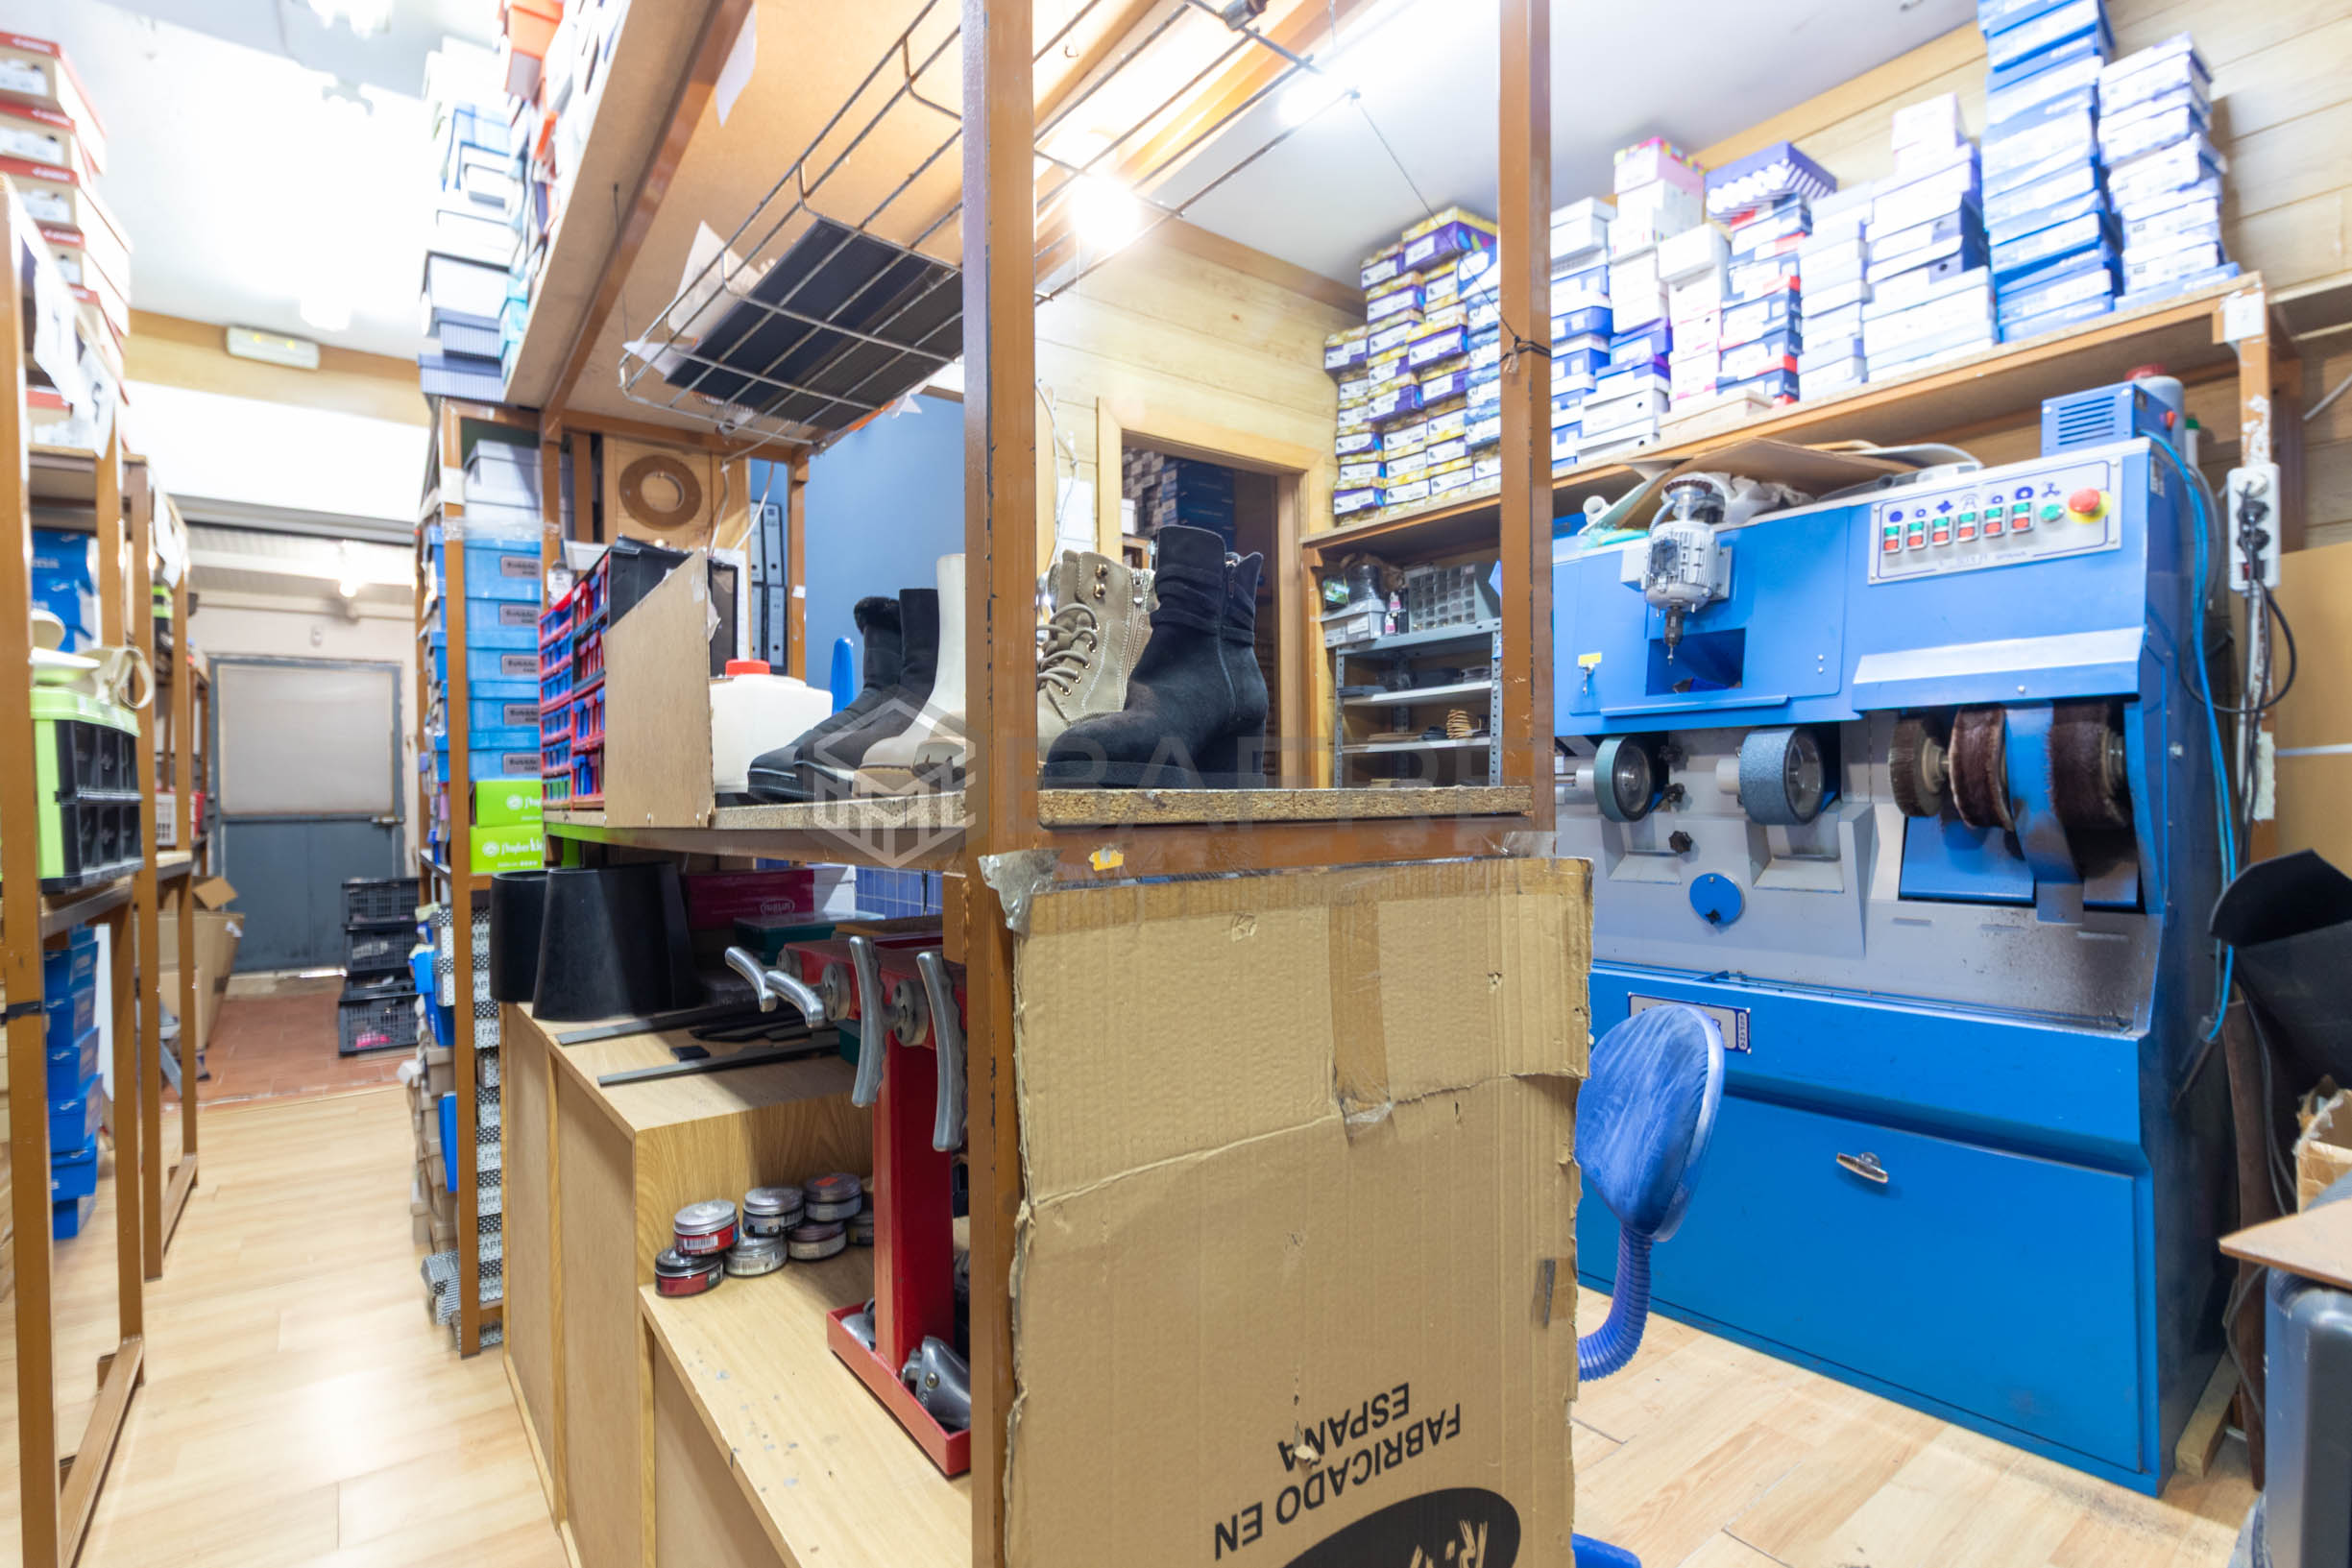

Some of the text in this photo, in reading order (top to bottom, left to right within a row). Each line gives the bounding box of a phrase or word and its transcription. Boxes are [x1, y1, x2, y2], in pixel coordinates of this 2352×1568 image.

[1214, 1403, 1461, 1561] FABRICADO EN
[1276, 1383, 1410, 1473] ESPAÑA
